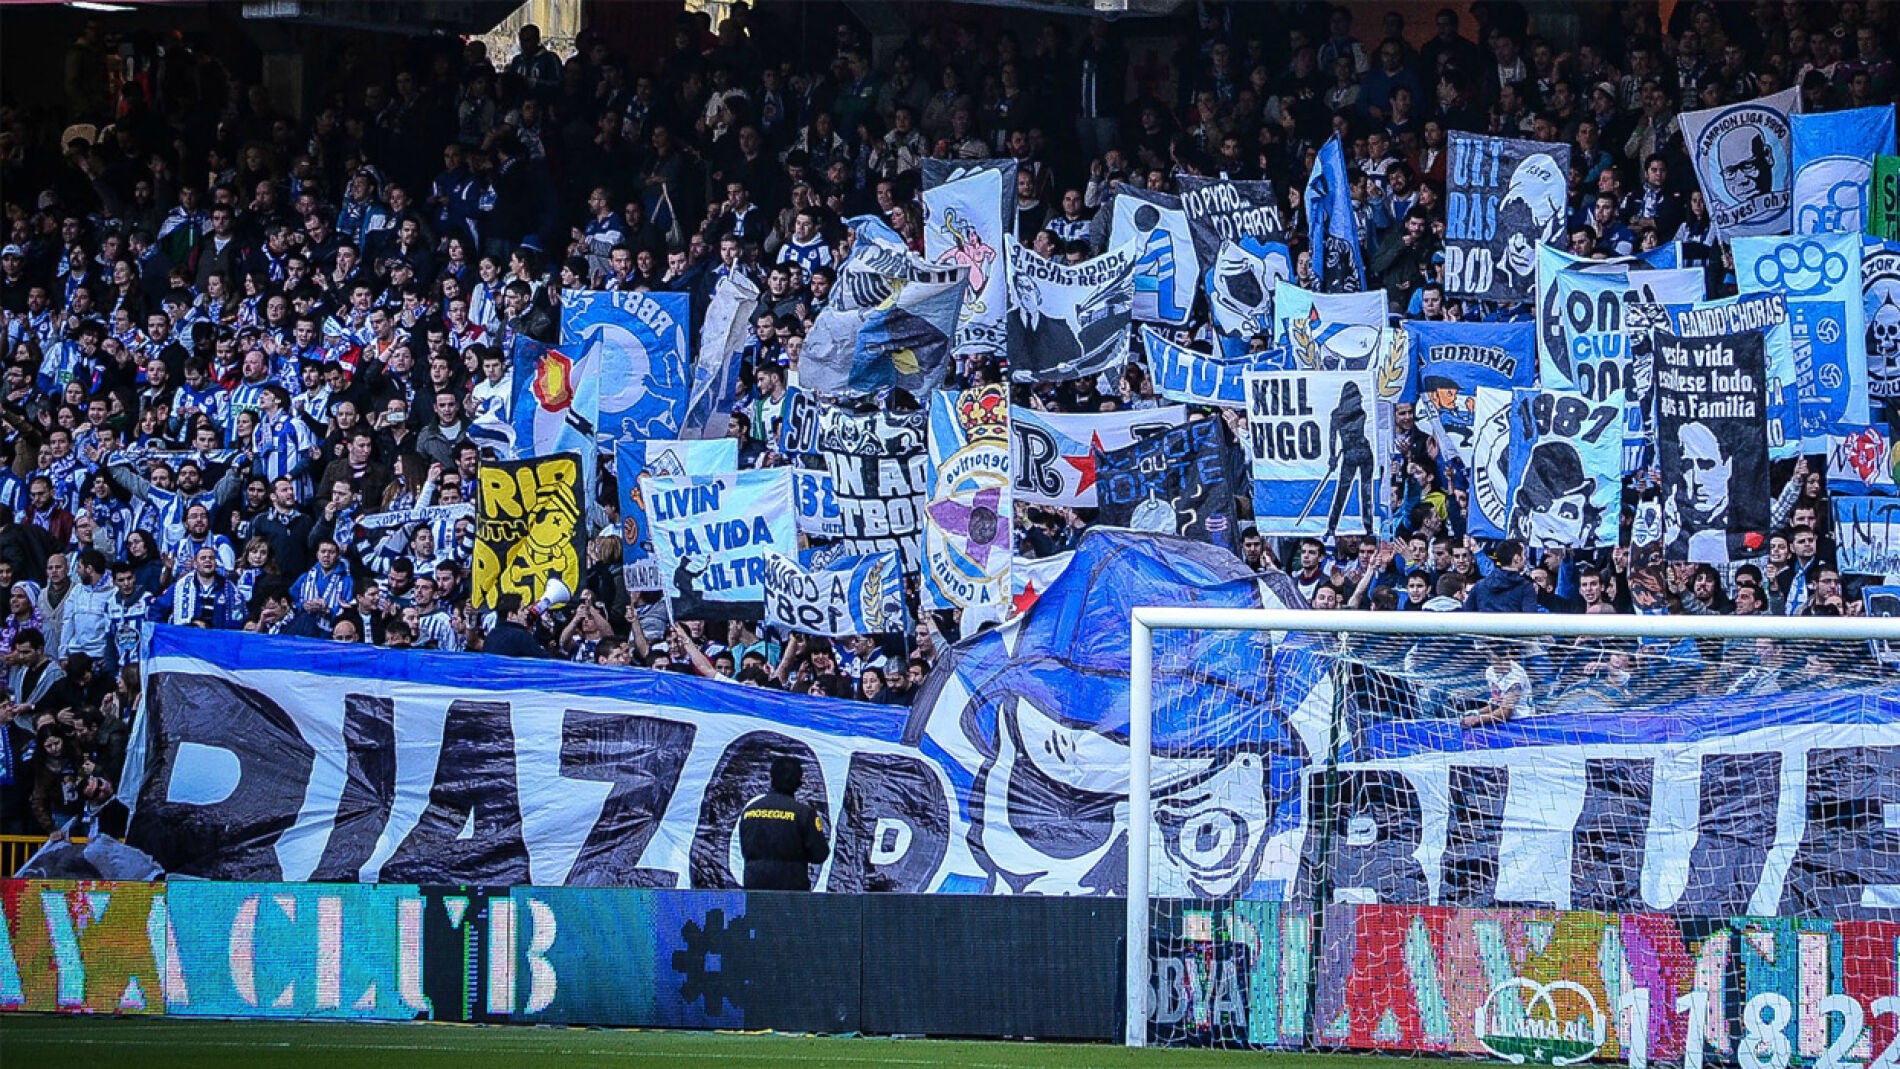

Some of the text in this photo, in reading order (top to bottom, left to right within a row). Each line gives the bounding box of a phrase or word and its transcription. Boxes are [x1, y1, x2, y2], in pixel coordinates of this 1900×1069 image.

[1740, 112, 1763, 124] LIGA
[1453, 138, 1504, 188] ULT
[1446, 192, 1501, 241] RAS
[1445, 245, 1493, 293] RCD
[1678, 294, 1785, 338] CANDO CHORAS
[1430, 344, 1518, 380] CORUÑA
[1693, 342, 1734, 367] vida
[1251, 377, 1314, 417] KILL
[1688, 394, 1756, 418] Familia
[1518, 393, 1620, 444] 1987
[1250, 420, 1322, 461] VIGO
[650, 479, 726, 522] LIVIN'
[669, 515, 774, 558] LA VIDA
[743, 808, 795, 821] PROSEGUR
